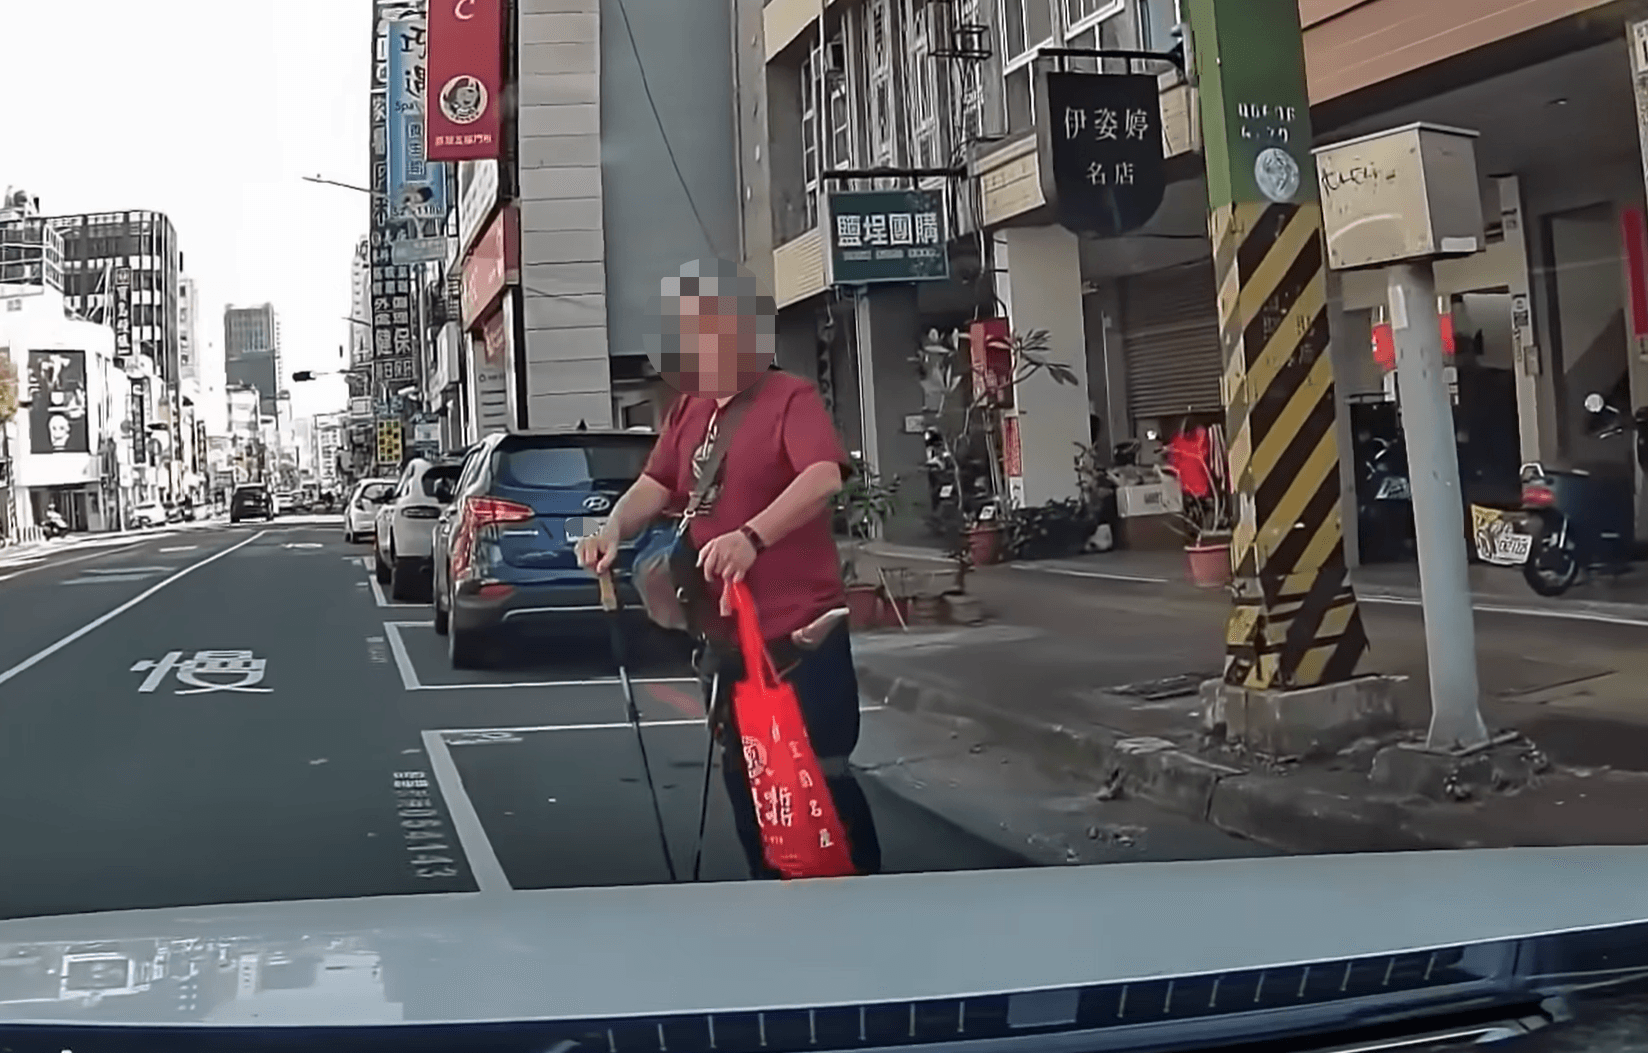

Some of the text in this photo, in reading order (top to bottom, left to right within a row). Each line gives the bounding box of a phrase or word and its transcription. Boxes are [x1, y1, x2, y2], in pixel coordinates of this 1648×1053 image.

[1065, 106, 1149, 140] 伊姿婷
[1086, 161, 1134, 185] 名店
[836, 212, 938, 247] 鹽埕團購
[130, 650, 273, 695] 慢
